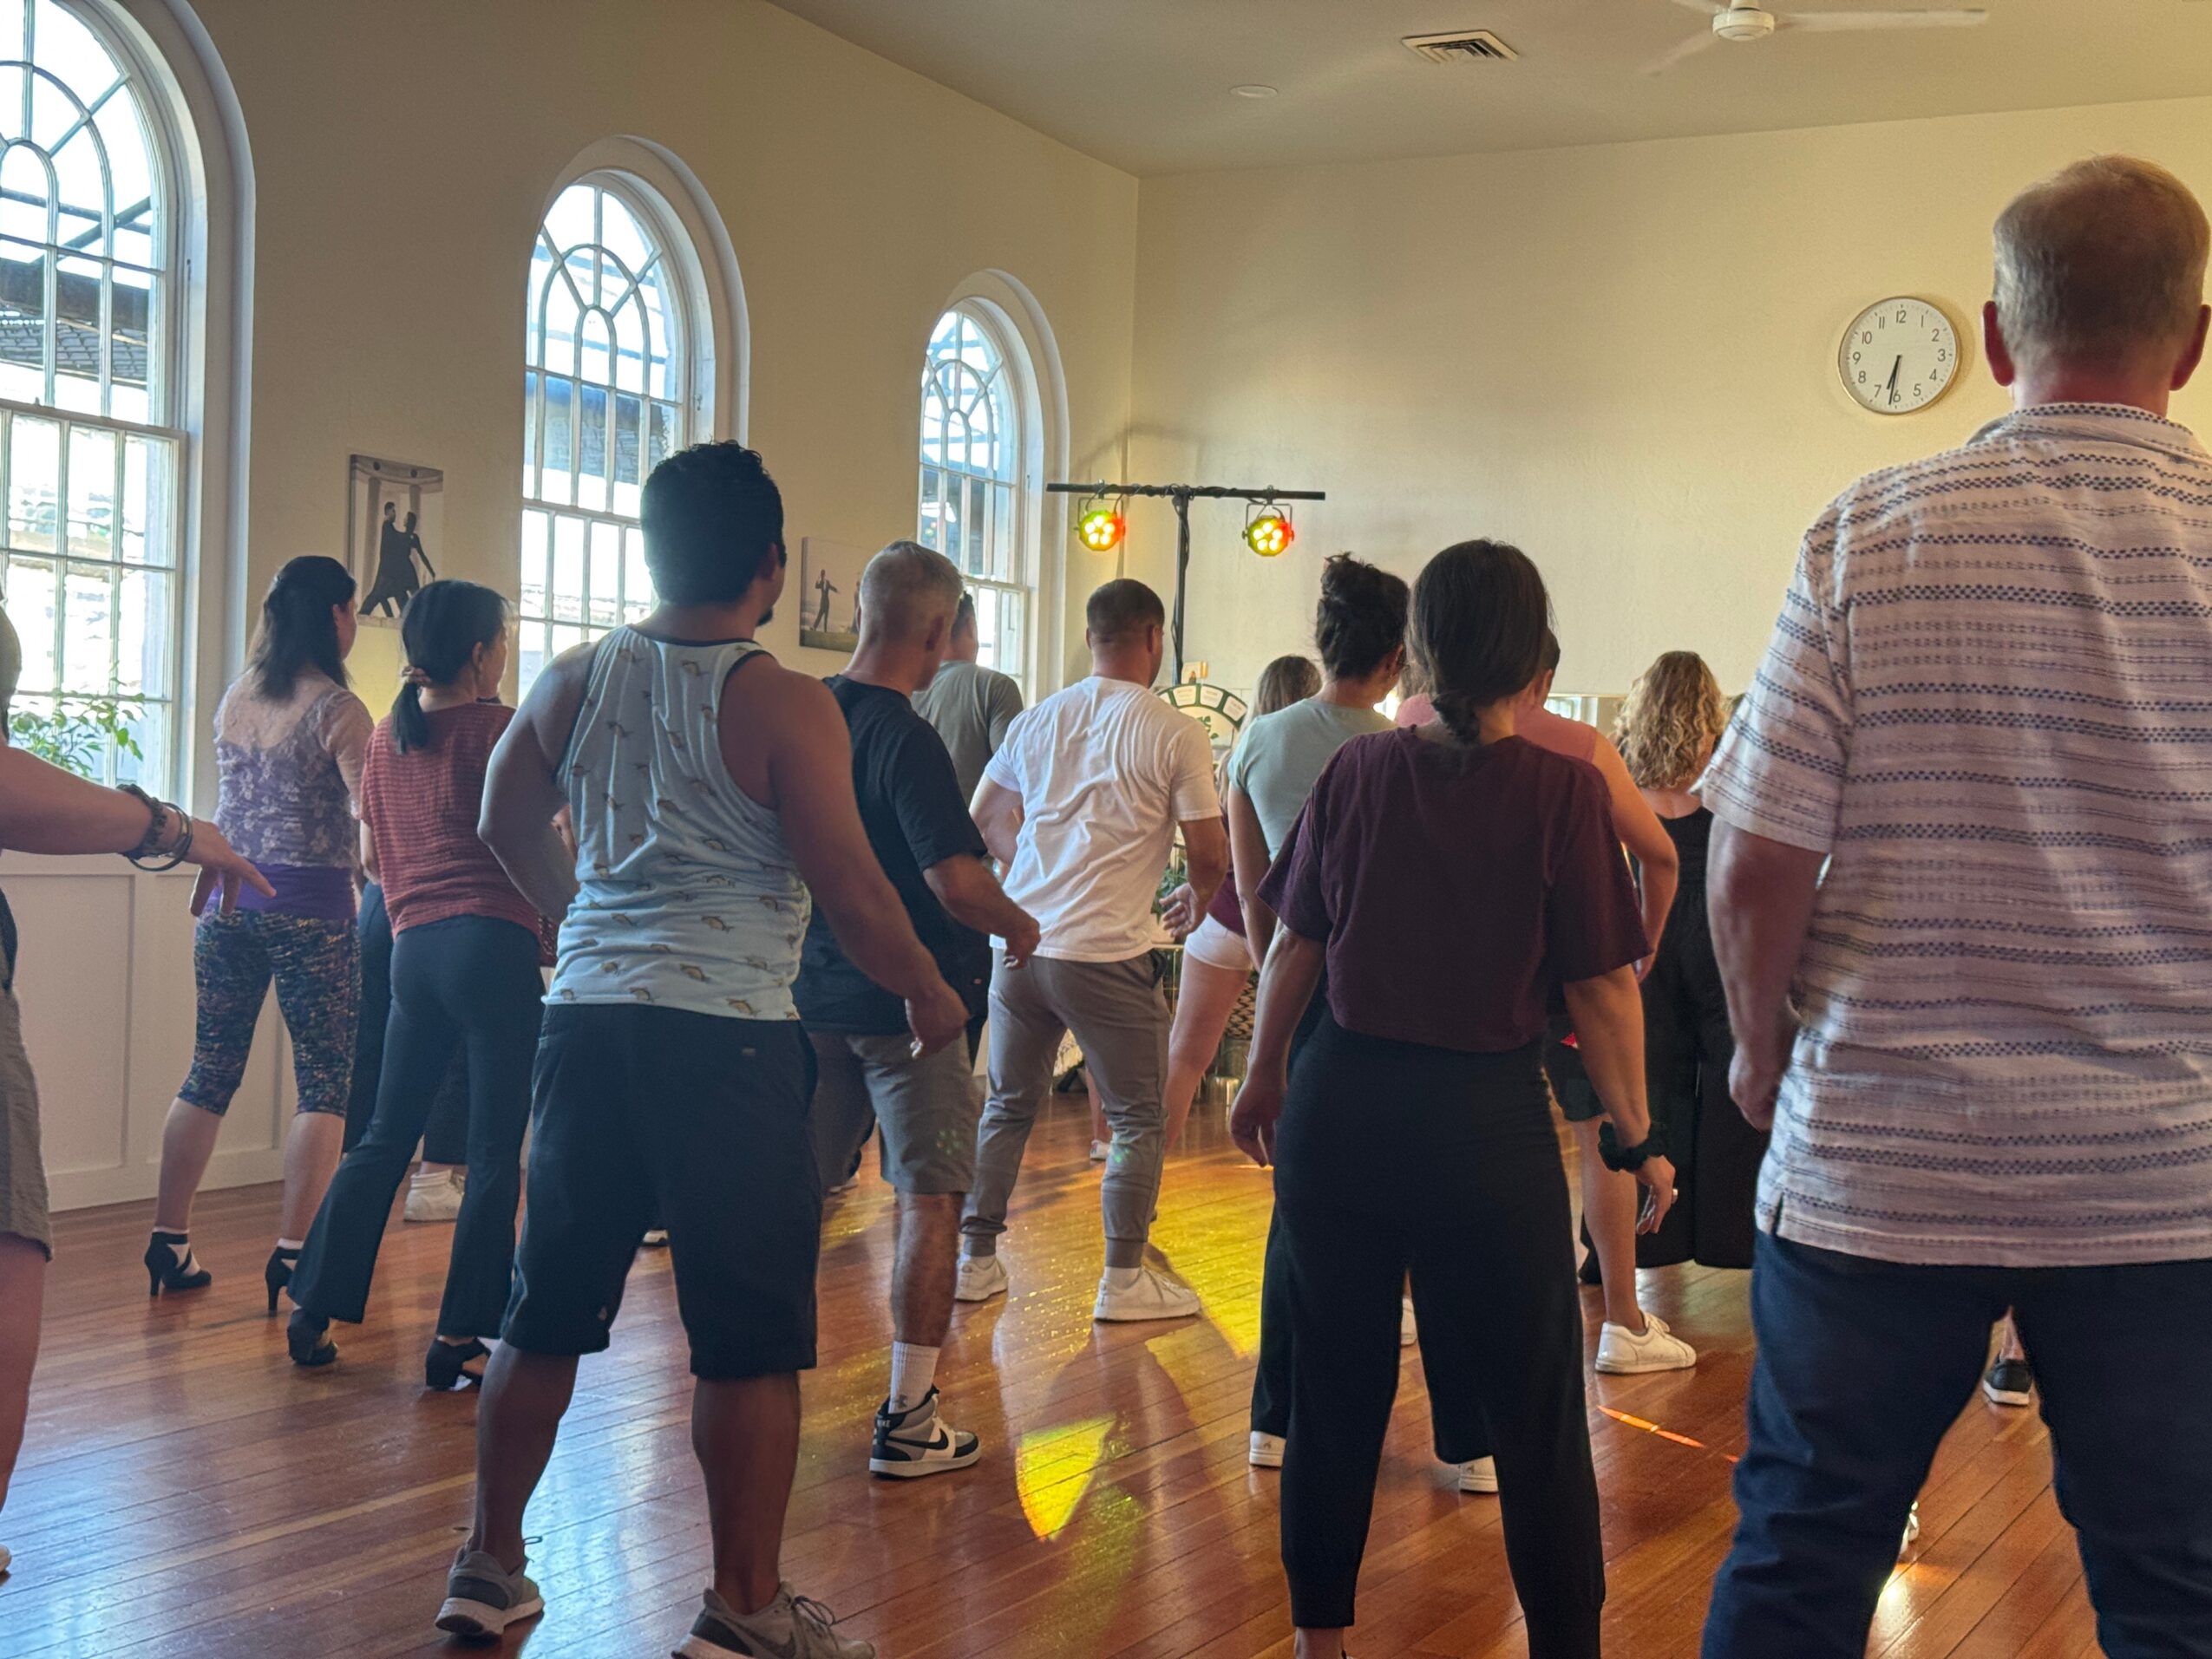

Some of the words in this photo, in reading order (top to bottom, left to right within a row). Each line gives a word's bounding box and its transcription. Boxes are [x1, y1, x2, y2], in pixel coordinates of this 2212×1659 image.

[1879, 316, 1885, 329] 11
[1896, 310, 1907, 323] 12
[1921, 315, 1924, 328] 1
[1862, 331, 1873, 345] 10
[1931, 329, 1940, 342] 2
[1853, 352, 1861, 364] 9
[1938, 349, 1946, 362] 3
[1858, 370, 1866, 383] 8
[1929, 369, 1937, 382] 4
[1874, 385, 1882, 398] 7
[1893, 389, 1901, 402] 6
[1913, 383, 1921, 396] 5
